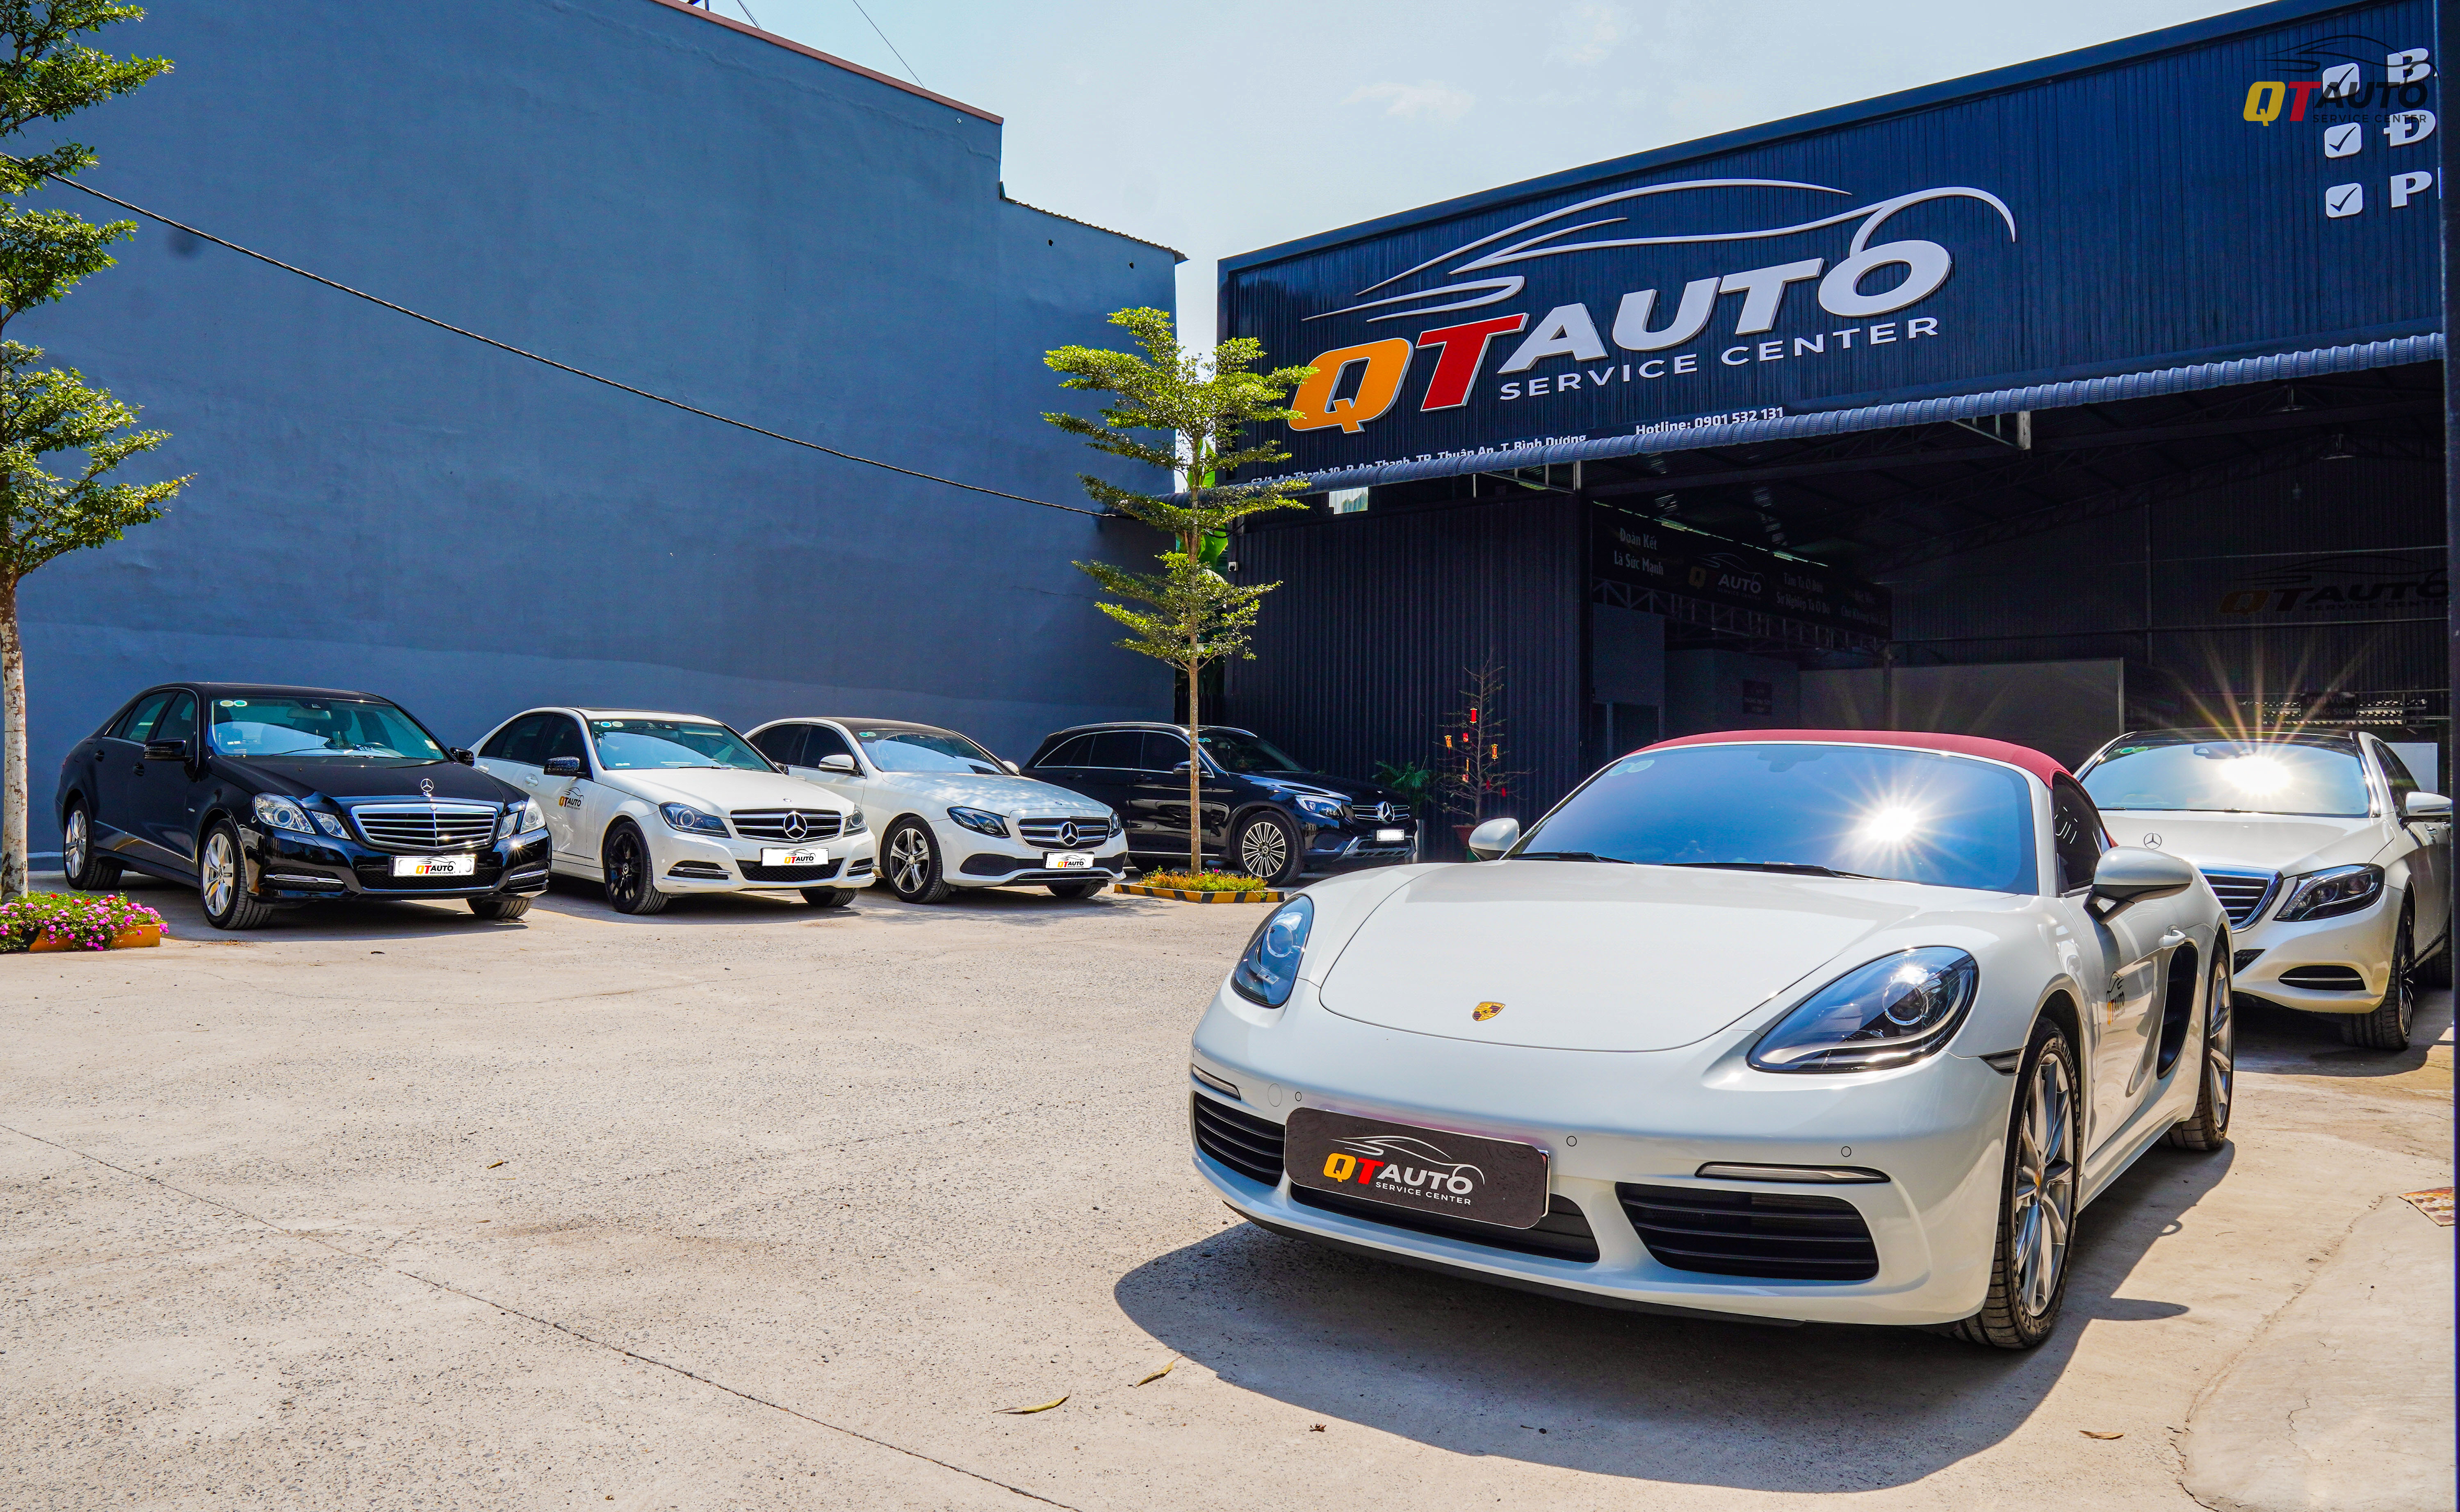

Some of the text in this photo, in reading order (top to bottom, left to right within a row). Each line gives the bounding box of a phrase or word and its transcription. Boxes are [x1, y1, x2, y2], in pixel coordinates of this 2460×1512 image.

[2387, 48, 2438, 87] B
[1500, 317, 1938, 401] SERVICE CENTER
[1636, 407, 1783, 435] Hotline: 0901 532 131
[1514, 438, 1542, 450] Bình
[1614, 550, 1623, 566] Là
[2305, 600, 2447, 611] SERVICE CENTE
[1376, 1182, 1471, 1205] SERVICE CENTER
